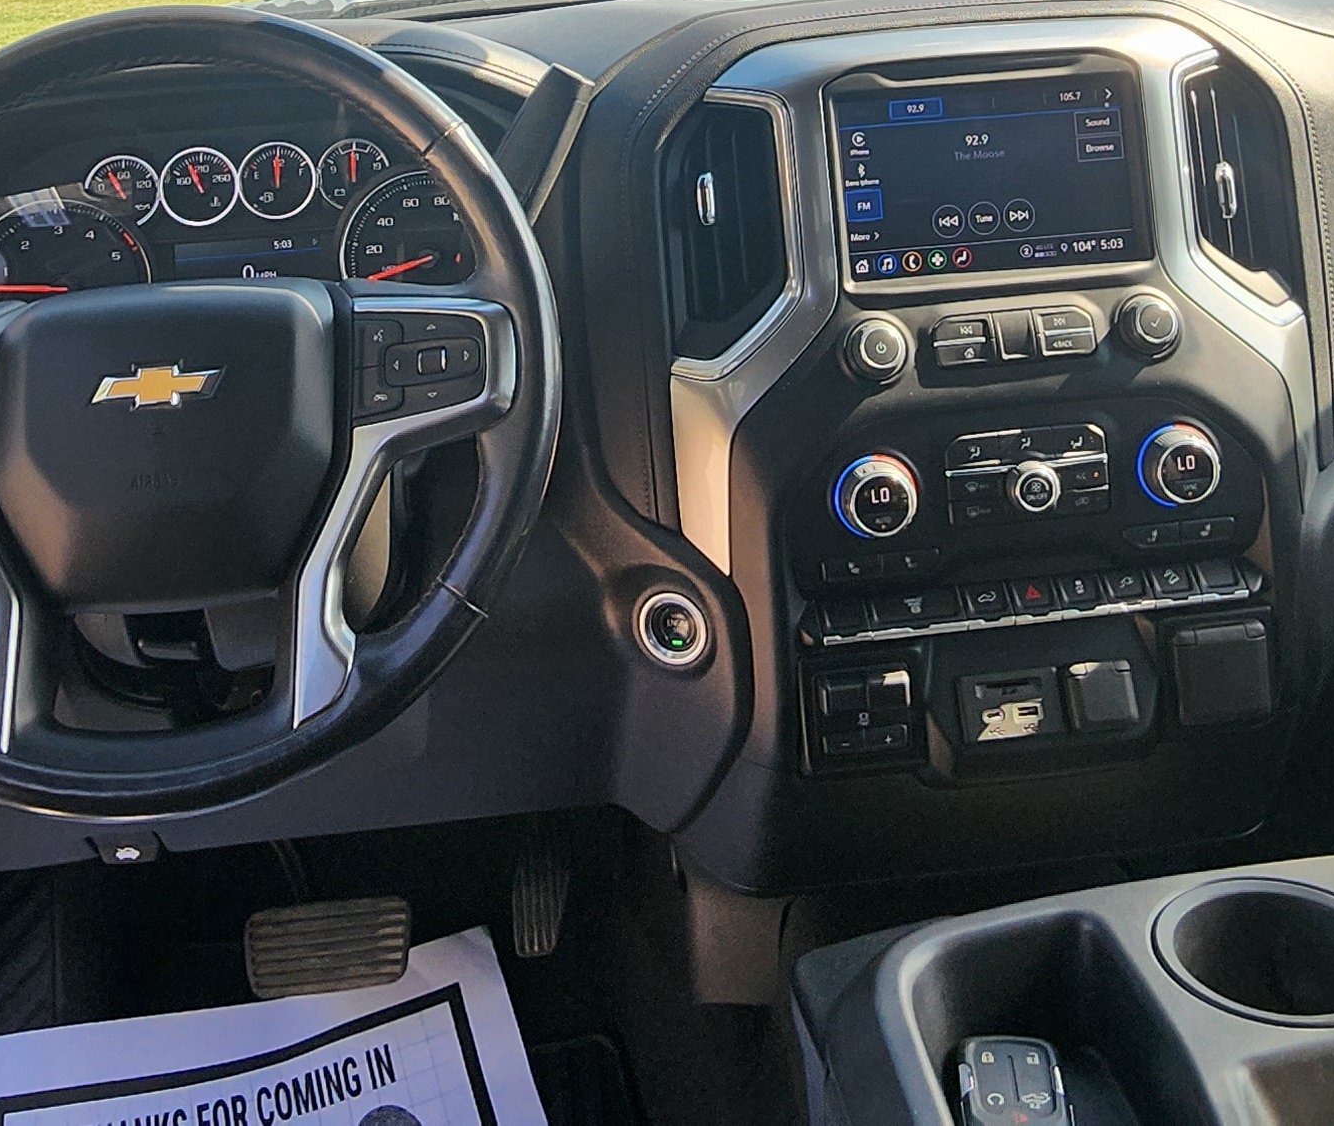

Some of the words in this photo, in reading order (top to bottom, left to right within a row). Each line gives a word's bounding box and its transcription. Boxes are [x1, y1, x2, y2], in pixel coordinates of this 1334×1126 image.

[1059, 91, 1082, 102] 105.7
[906, 103, 925, 113] 92.9
[1085, 117, 1110, 128] Sound
[964, 133, 989, 147] 92.9
[1085, 143, 1115, 153] Browse
[954, 152, 971, 161] The
[973, 149, 1006, 160] Moose
[117, 170, 130, 180] 60
[212, 174, 231, 183] 260
[136, 180, 152, 189] 120
[175, 177, 192, 186] 160
[97, 183, 105, 192] 0
[402, 197, 419, 208] 60
[433, 196, 451, 206] 80
[857, 202, 871, 212] FM
[376, 217, 394, 227] 40
[975, 214, 994, 223] Tune
[53, 225, 64, 236] 3
[84, 230, 95, 240] 4
[850, 233, 871, 242] More
[20, 240, 31, 250] 2
[273, 239, 293, 250] 5:03
[1072, 240, 1097, 252] 104°
[1099, 238, 1124, 250] 5:03
[365, 244, 383, 255] 20
[111, 251, 122, 262] 5
[242, 264, 255, 279] 0
[1177, 454, 1196, 471] LO
[870, 486, 890, 504] LO
[1026, 492, 1048, 501] ON/OFF
[197, 1094, 248, 1126] FOR
[257, 1056, 362, 1126] COMING
[365, 1043, 397, 1091] IN
